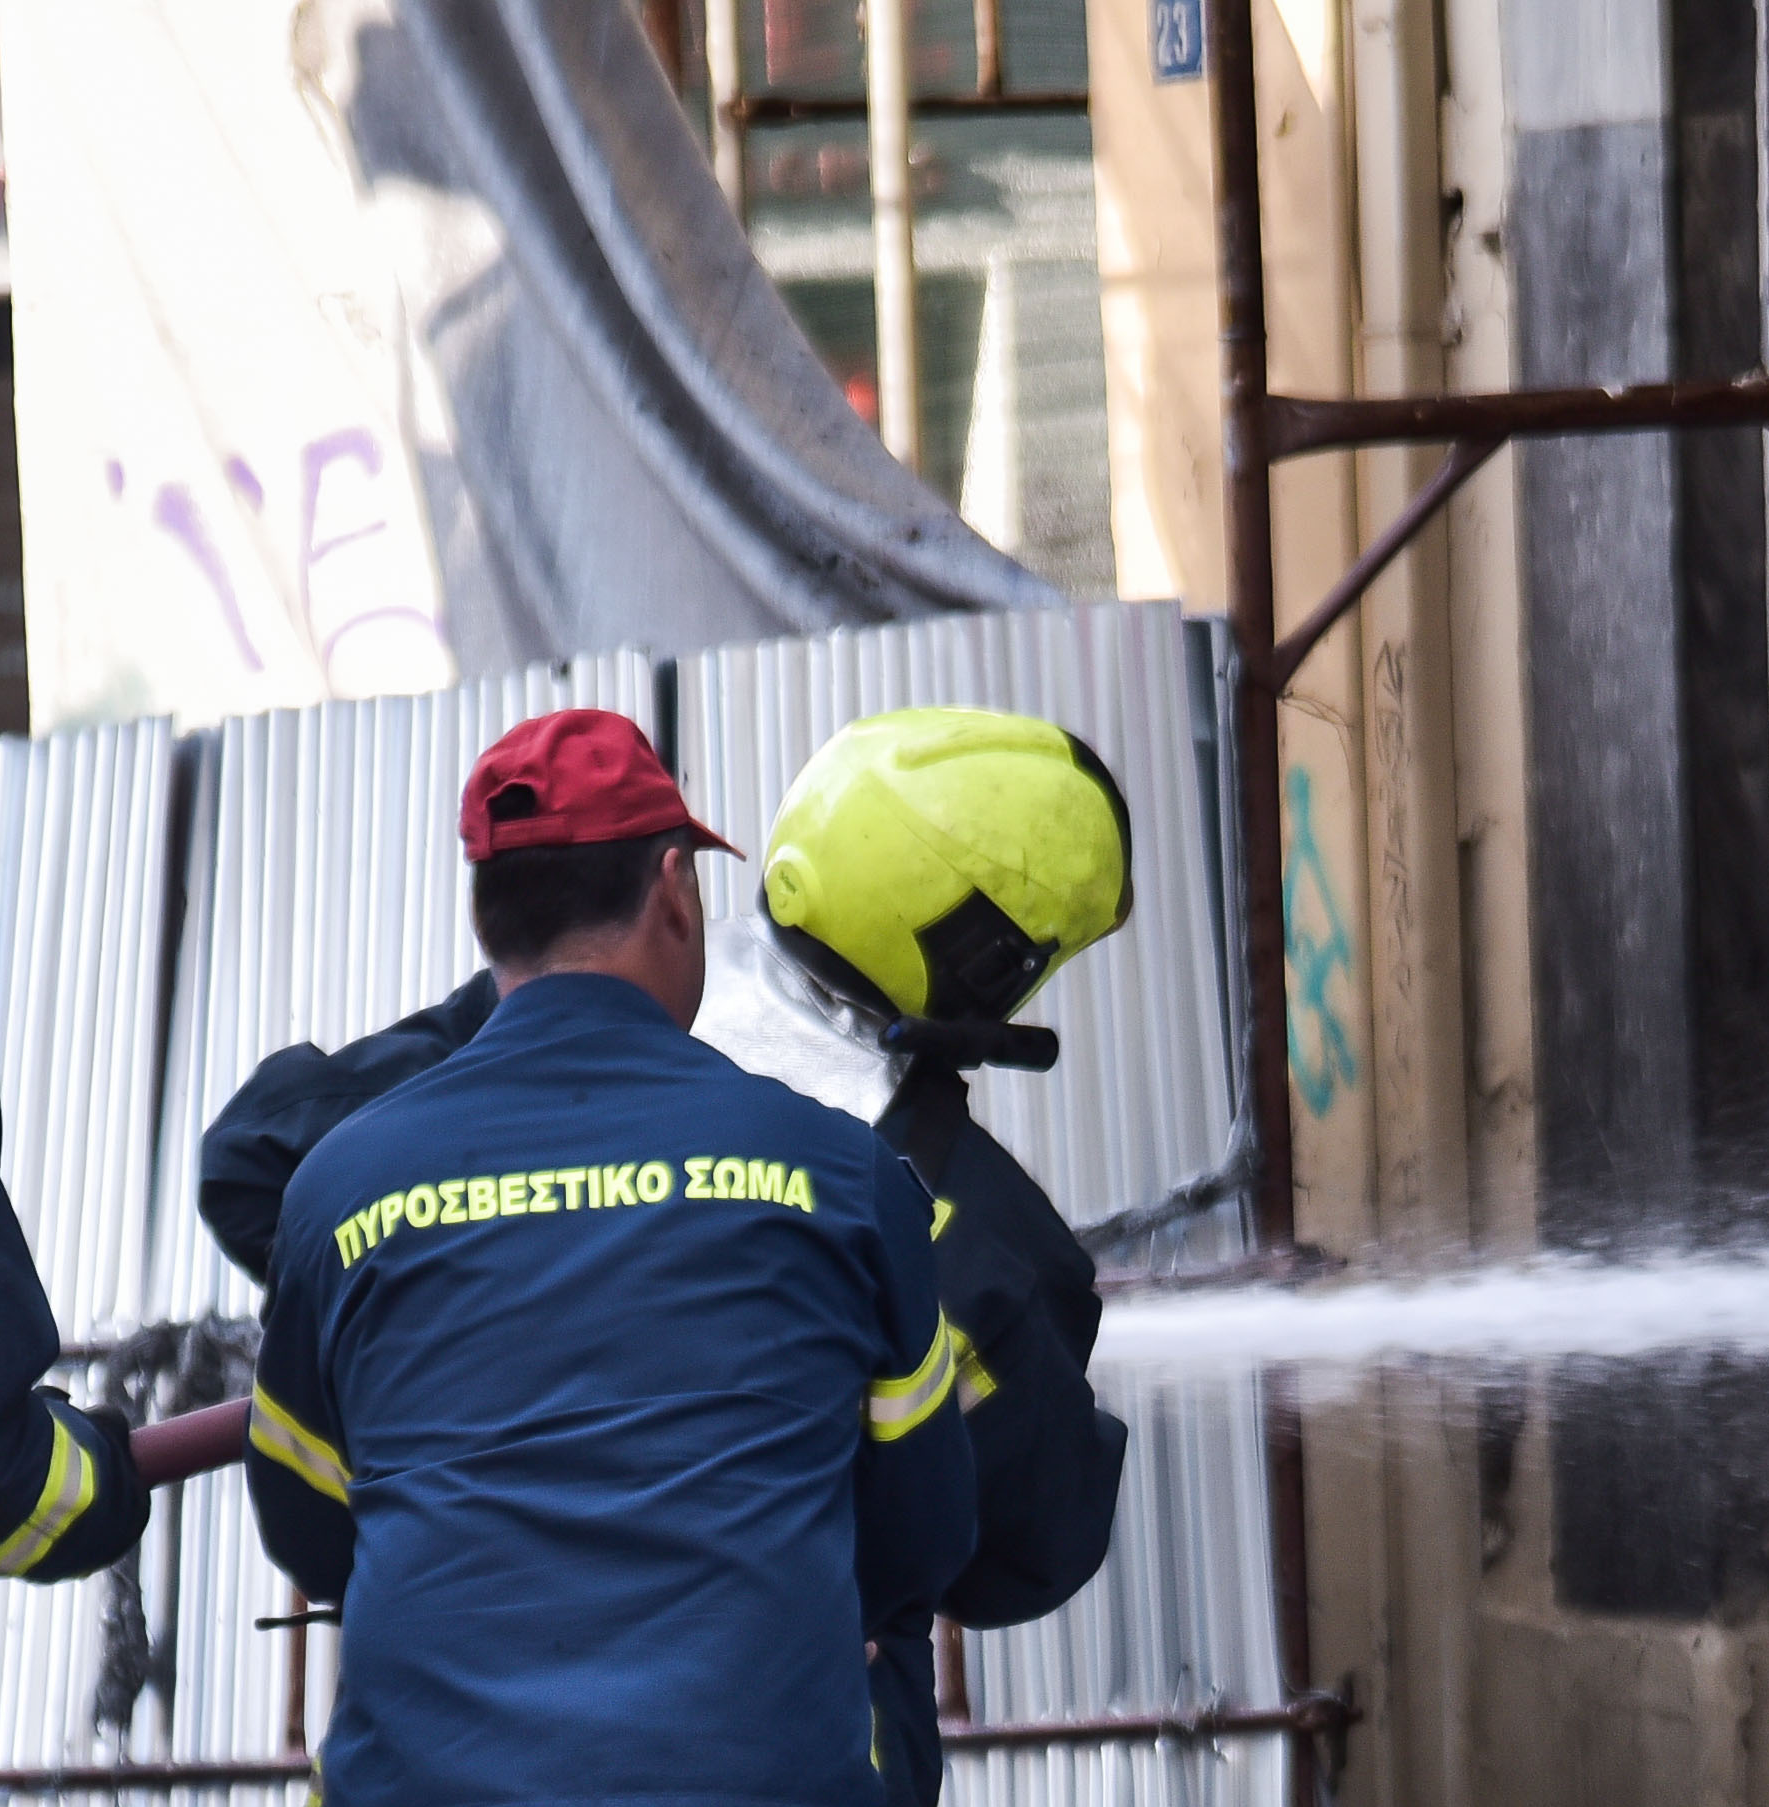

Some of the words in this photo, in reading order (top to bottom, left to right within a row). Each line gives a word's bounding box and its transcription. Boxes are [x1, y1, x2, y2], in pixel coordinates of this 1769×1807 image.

[1155, 2, 1189, 67] 23
[333, 1160, 672, 1270] ΠΥΡΟΣΒΕΣΤΙΚΟ
[683, 1157, 815, 1214] ΣΩΜΑ
